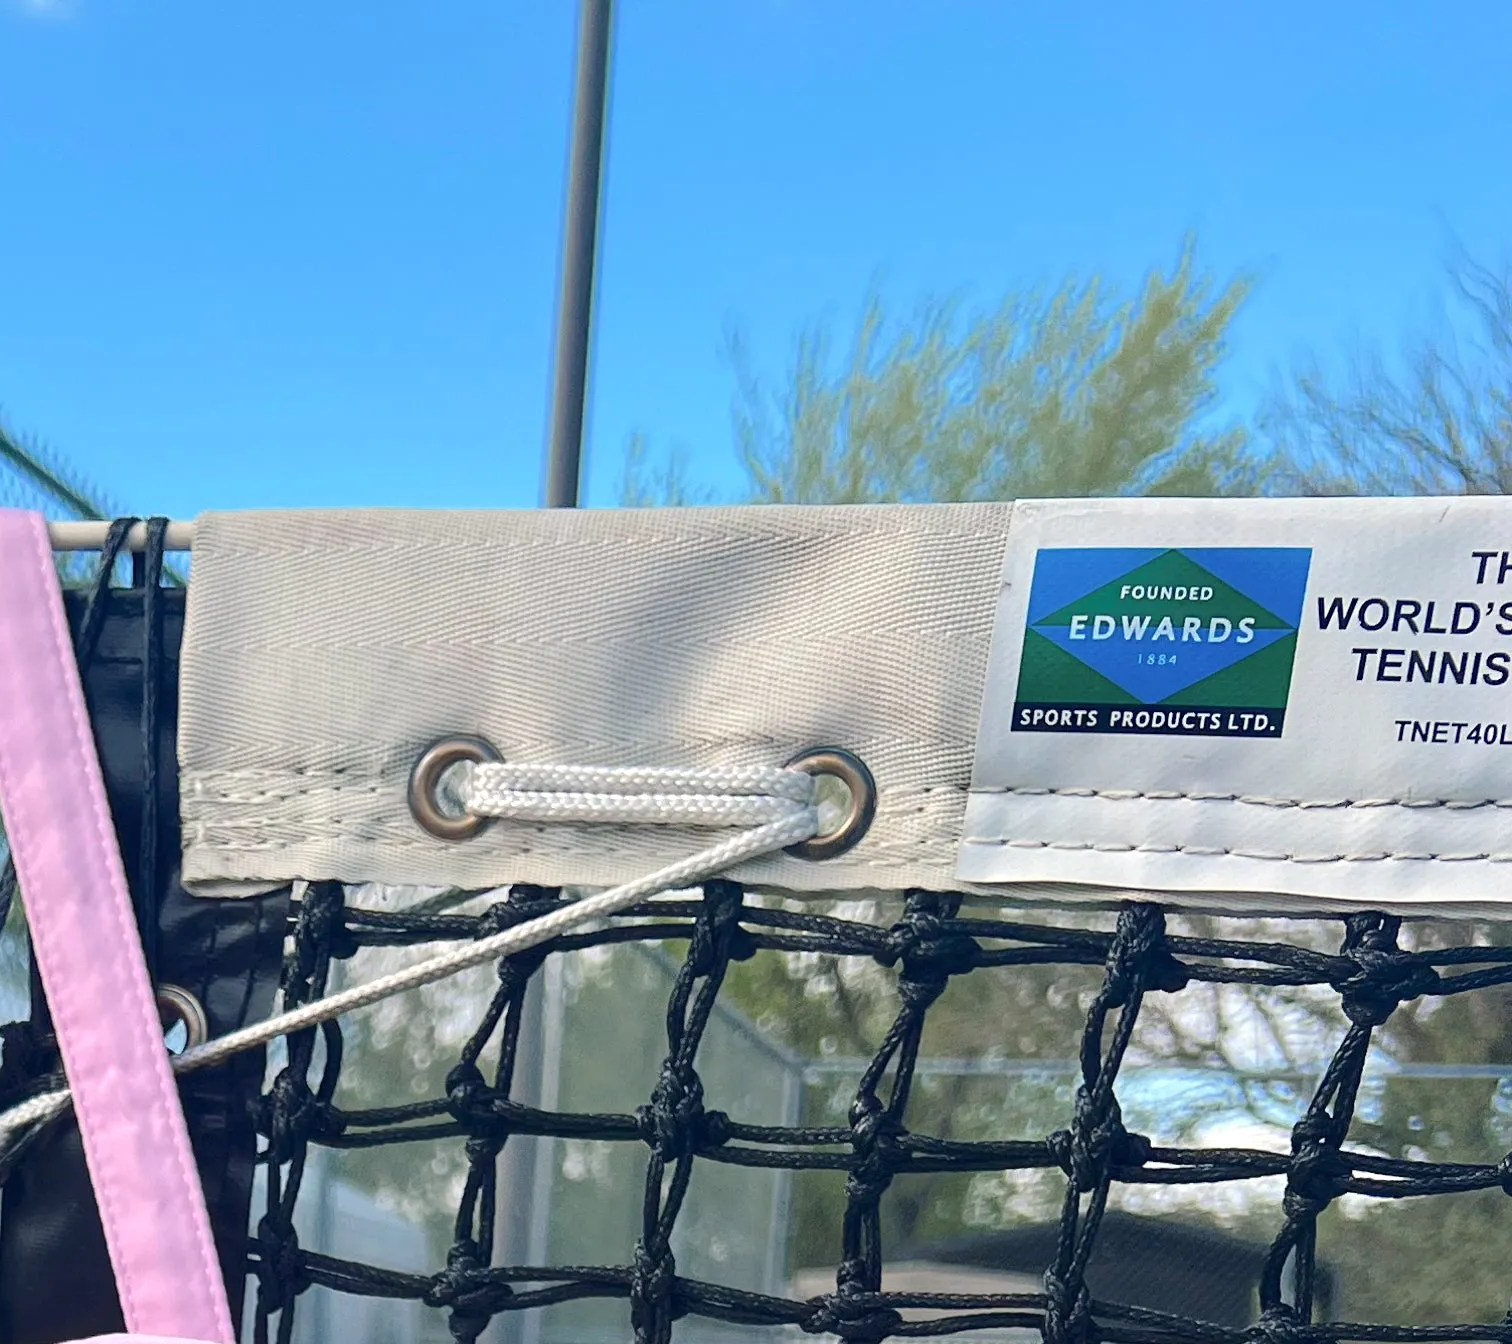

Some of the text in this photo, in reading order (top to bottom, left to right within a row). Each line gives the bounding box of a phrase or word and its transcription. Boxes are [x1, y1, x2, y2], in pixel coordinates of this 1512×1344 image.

[1120, 585, 1214, 601] FOUNDED
[1317, 597, 1512, 635] WORLD'S
[1069, 615, 1256, 643] EDWARDS
[1137, 653, 1177, 665] 1884
[1352, 648, 1511, 686] TENNIS
[1019, 708, 1276, 731] SPORTS PRODUCTS LTD.
